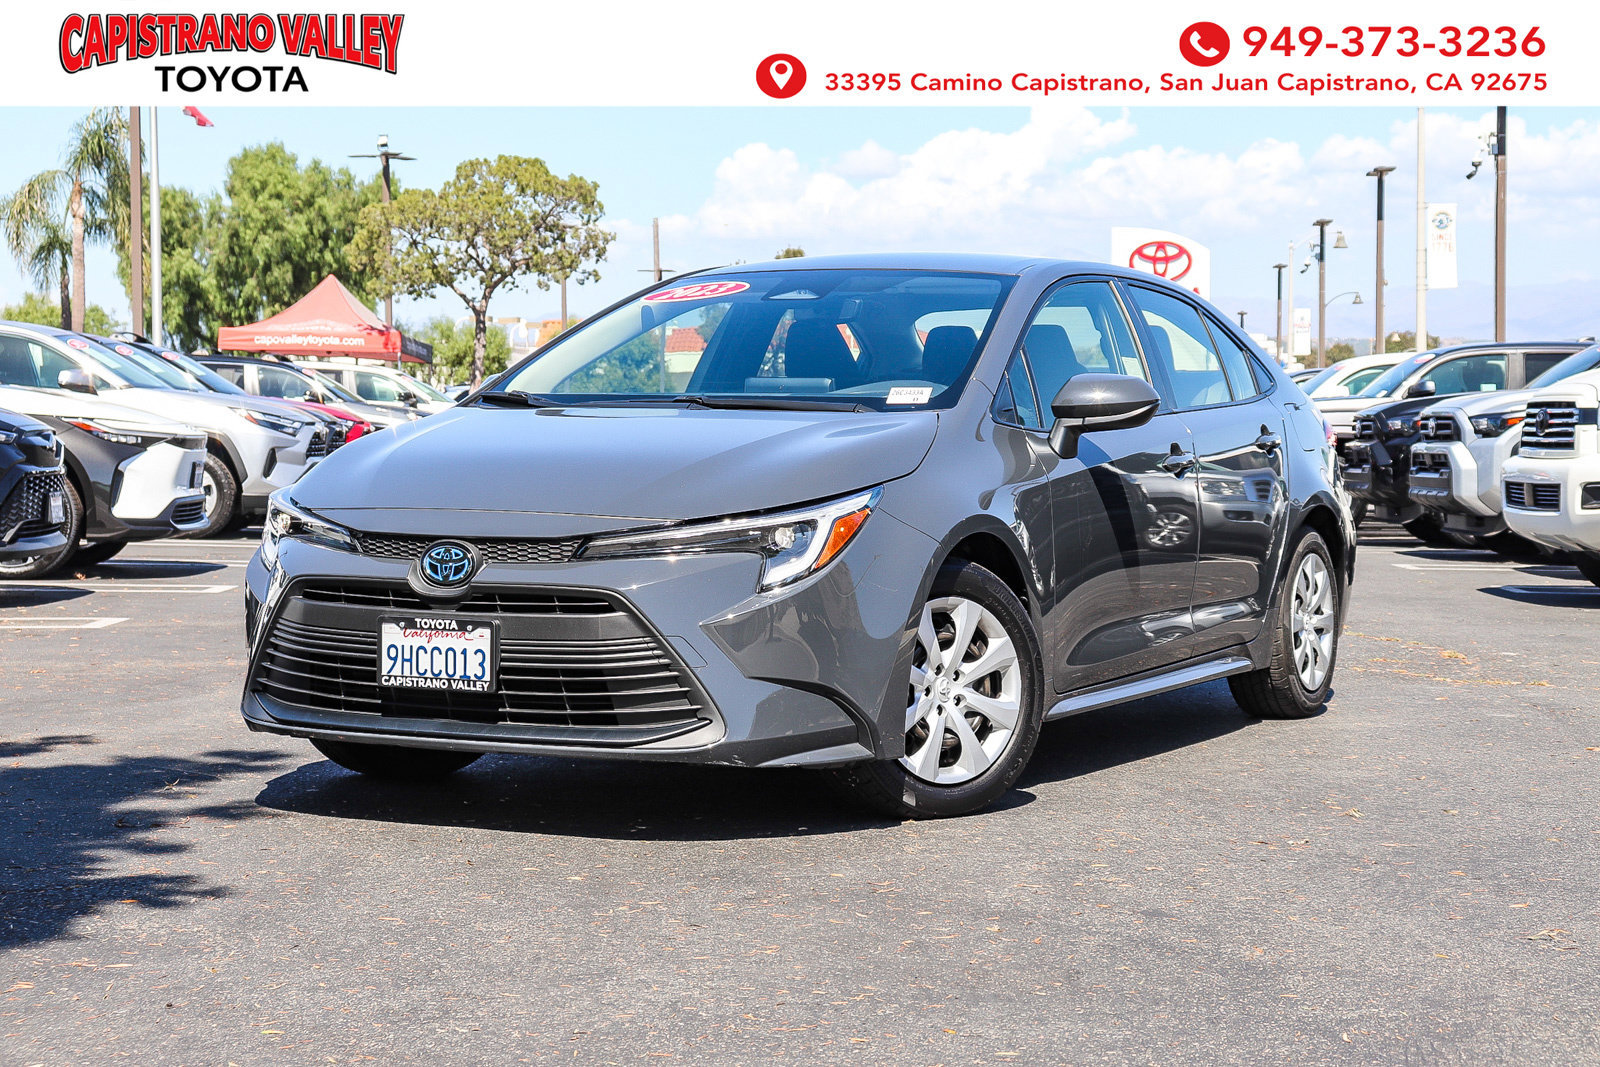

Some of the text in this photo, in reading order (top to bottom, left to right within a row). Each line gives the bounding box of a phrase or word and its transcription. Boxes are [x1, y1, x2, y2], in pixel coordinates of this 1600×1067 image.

[254, 333, 365, 347] capovalleytoyota.com
[414, 618, 458, 630] TOYOTA
[386, 644, 486, 680] 9HCC013
[381, 675, 490, 692] CAPISTRANO VALLEY
